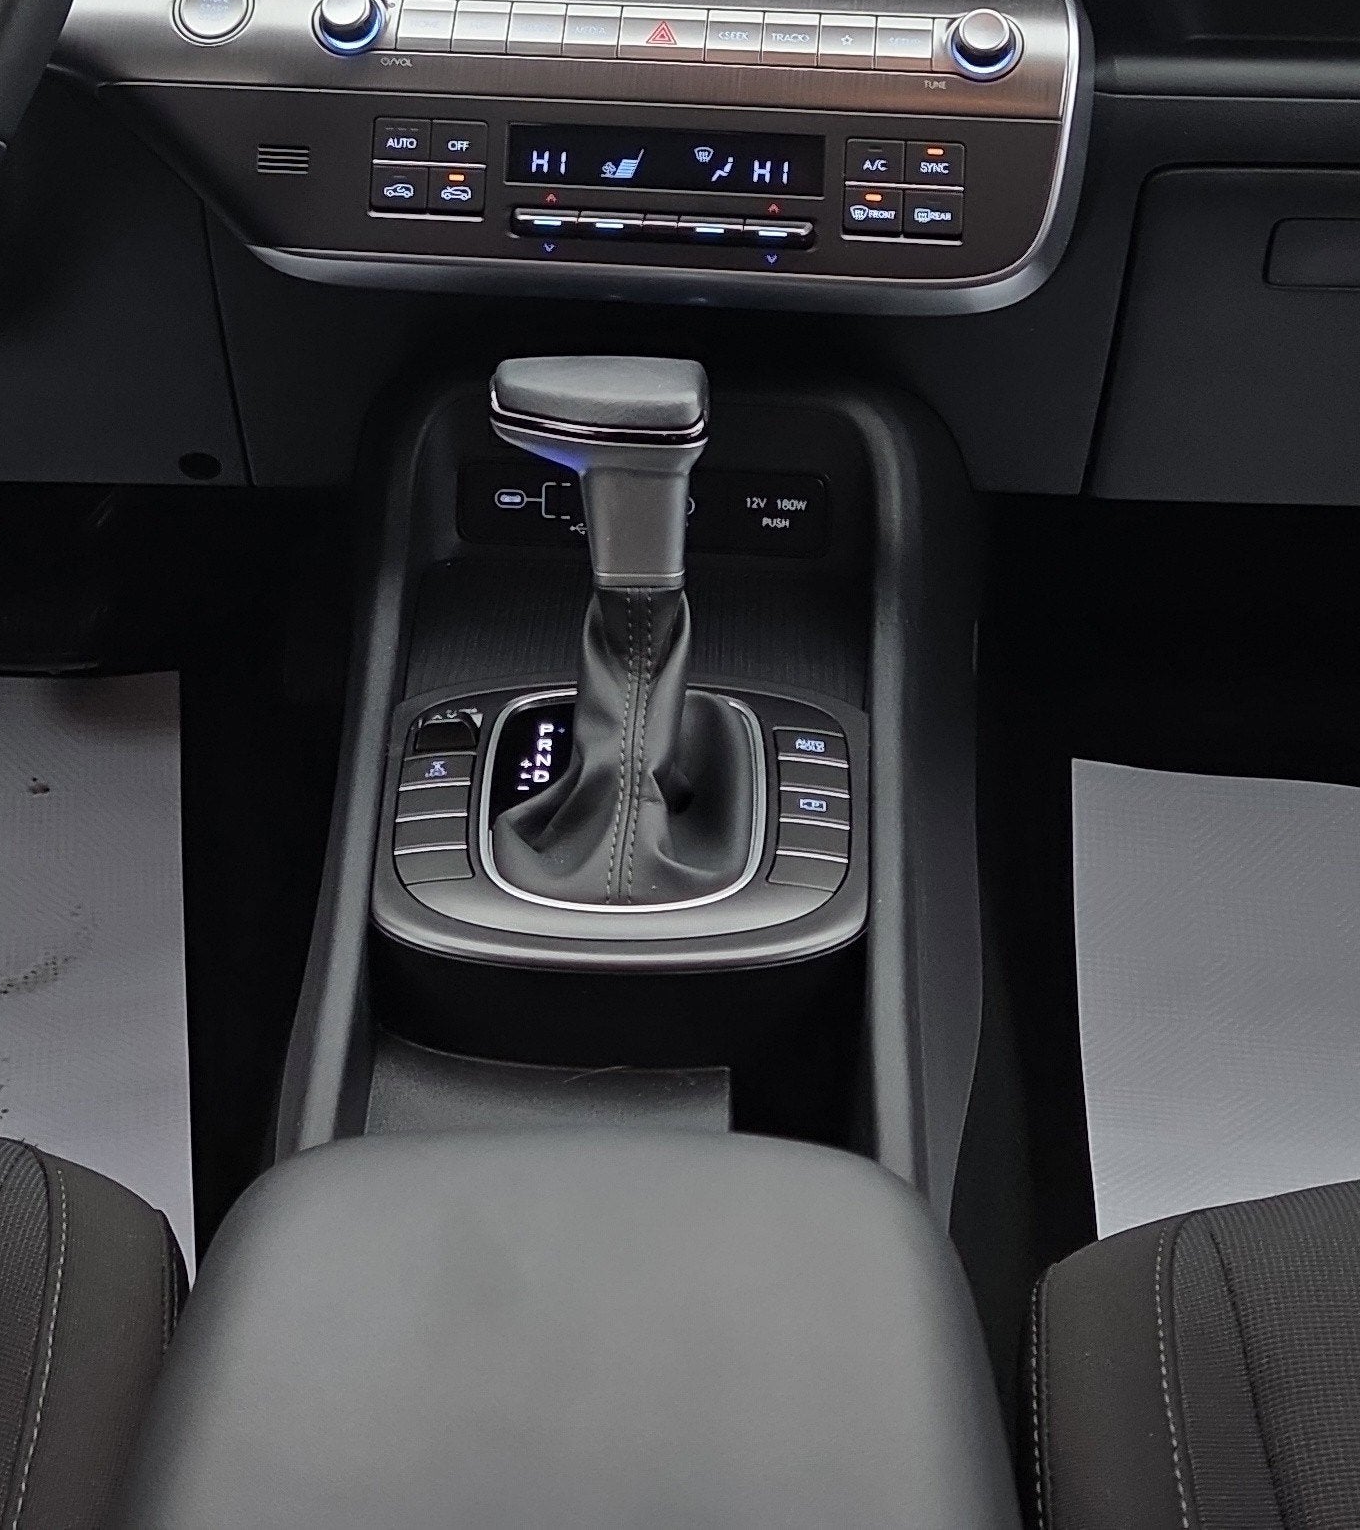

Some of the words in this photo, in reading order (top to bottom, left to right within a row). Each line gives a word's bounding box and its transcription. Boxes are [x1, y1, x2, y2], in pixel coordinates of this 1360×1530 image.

[386, 137, 418, 150] AUTO
[447, 140, 471, 152] OFF
[862, 159, 888, 171] A/C
[920, 161, 950, 174] SYNC
[868, 210, 896, 220] FRONT
[929, 211, 952, 221] REAR
[745, 496, 768, 509] 12V
[761, 516, 790, 529] PUSH
[538, 723, 554, 737] P
[536, 738, 553, 752] R
[535, 753, 552, 767] N
[532, 770, 550, 783] D
